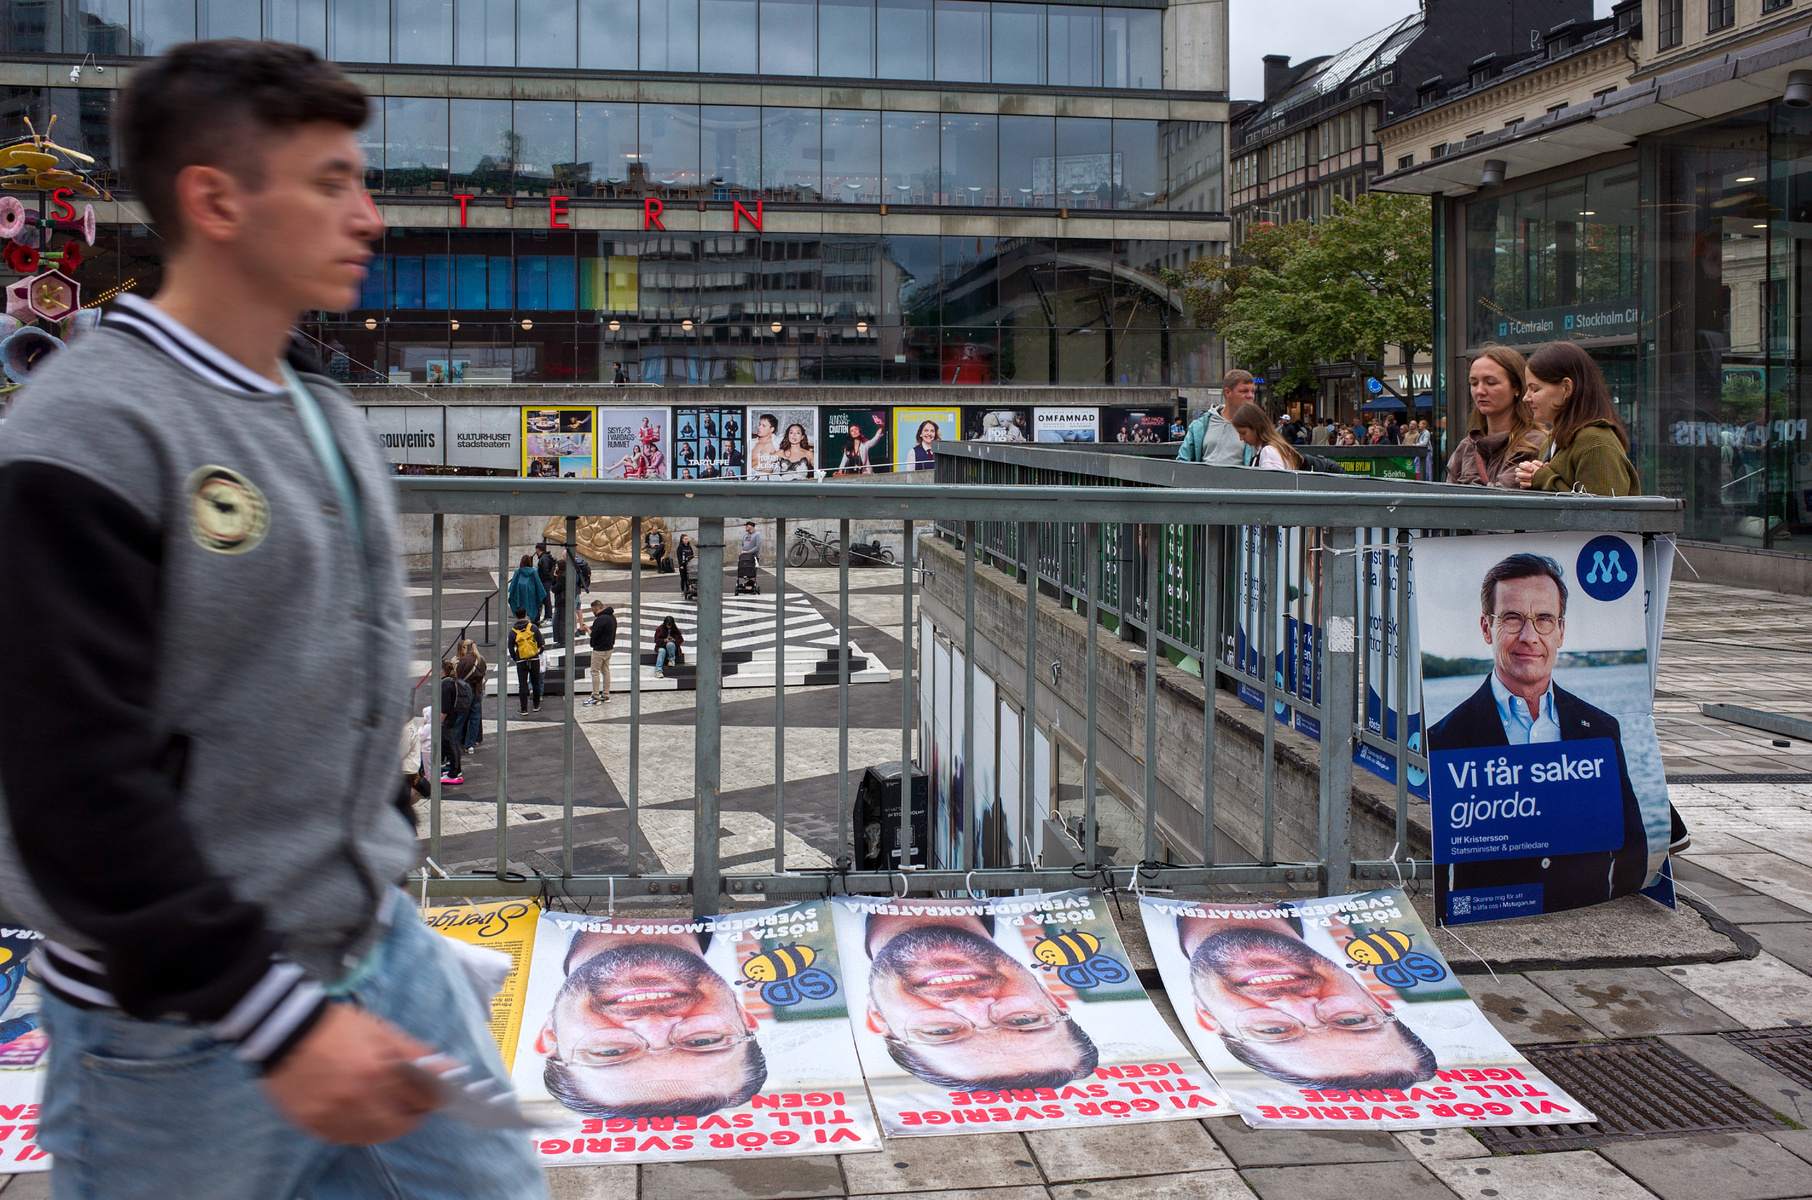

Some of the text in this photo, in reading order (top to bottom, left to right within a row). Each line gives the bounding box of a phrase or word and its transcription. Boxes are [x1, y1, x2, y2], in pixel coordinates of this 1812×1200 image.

[1510, 318, 1554, 335] T-Centralen
[1576, 311, 1624, 328] Stockholm
[900, 413, 948, 422] PARKTEATERN
[1038, 414, 1096, 422] OMFAMNAD
[457, 433, 512, 441] KULTURHUSET
[828, 425, 849, 434] CHATTEN
[379, 430, 435, 449] souvenirs
[457, 440, 511, 449] stadsteatern
[1383, 470, 1406, 478] Sänkta
[1447, 753, 1604, 789] Vi får saker
[1450, 791, 1542, 829] gjorda.
[1450, 833, 1510, 845] Ulf Kristersson
[1450, 841, 1550, 856] Statsminister & partiledare
[845, 896, 1091, 917] SVERIGEDEMOKRATERNA
[1153, 895, 1395, 920] SVERIGEDEMOKRATERNA
[1502, 899, 1536, 908] Mstugan.se
[555, 907, 818, 935] SVERIGEDEMOKRATERNA
[998, 909, 1096, 930] RÖSTA PÅ
[1308, 906, 1403, 931] RÖSTA PÅ
[714, 920, 819, 946] RÖSTA PÅ
[1093, 1062, 1184, 1080] IGEN
[1434, 1067, 1527, 1083] IGEN
[750, 1093, 846, 1109] IGEN
[948, 1078, 1201, 1106] TILL SVERIGE
[1298, 1083, 1548, 1104] TILL SVERIGE
[898, 1094, 1217, 1126] VI GÖR SVERIGE
[1256, 1099, 1571, 1121] VI GÖR SVERIGE
[580, 1109, 854, 1134] TILL SVERIGE
[533, 1126, 862, 1155] VI GÖR SVERIG
